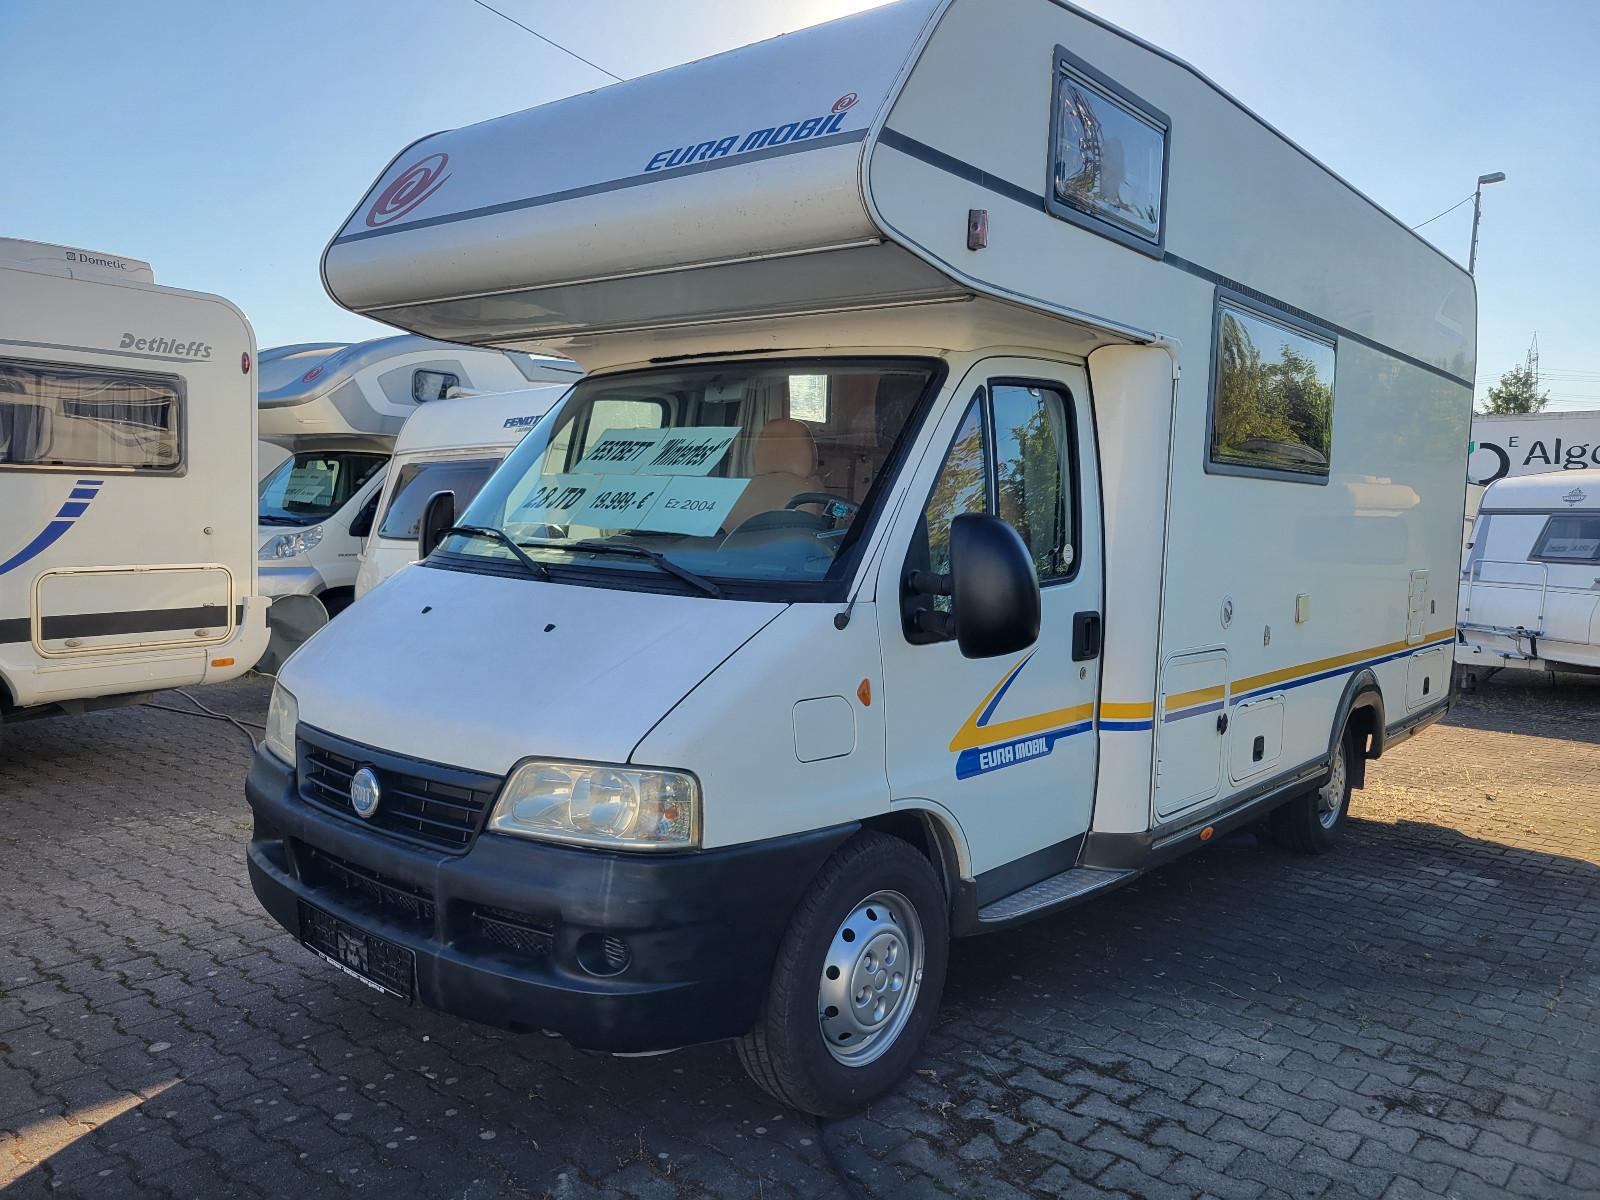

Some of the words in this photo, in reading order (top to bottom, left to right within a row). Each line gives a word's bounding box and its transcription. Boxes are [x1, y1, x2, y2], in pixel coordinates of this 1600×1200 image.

[644, 135, 740, 172] EURA
[737, 111, 848, 153] MOBIL
[79, 253, 127, 271] Dometic
[119, 332, 213, 358] Dethleffs
[584, 440, 656, 461] FESTBETT
[545, 486, 587, 510] JTD
[636, 491, 655, 510] €
[664, 498, 681, 509] Ez
[679, 499, 716, 511] 2004
[979, 747, 1014, 770] EURA
[1015, 737, 1049, 760] MOBIL
